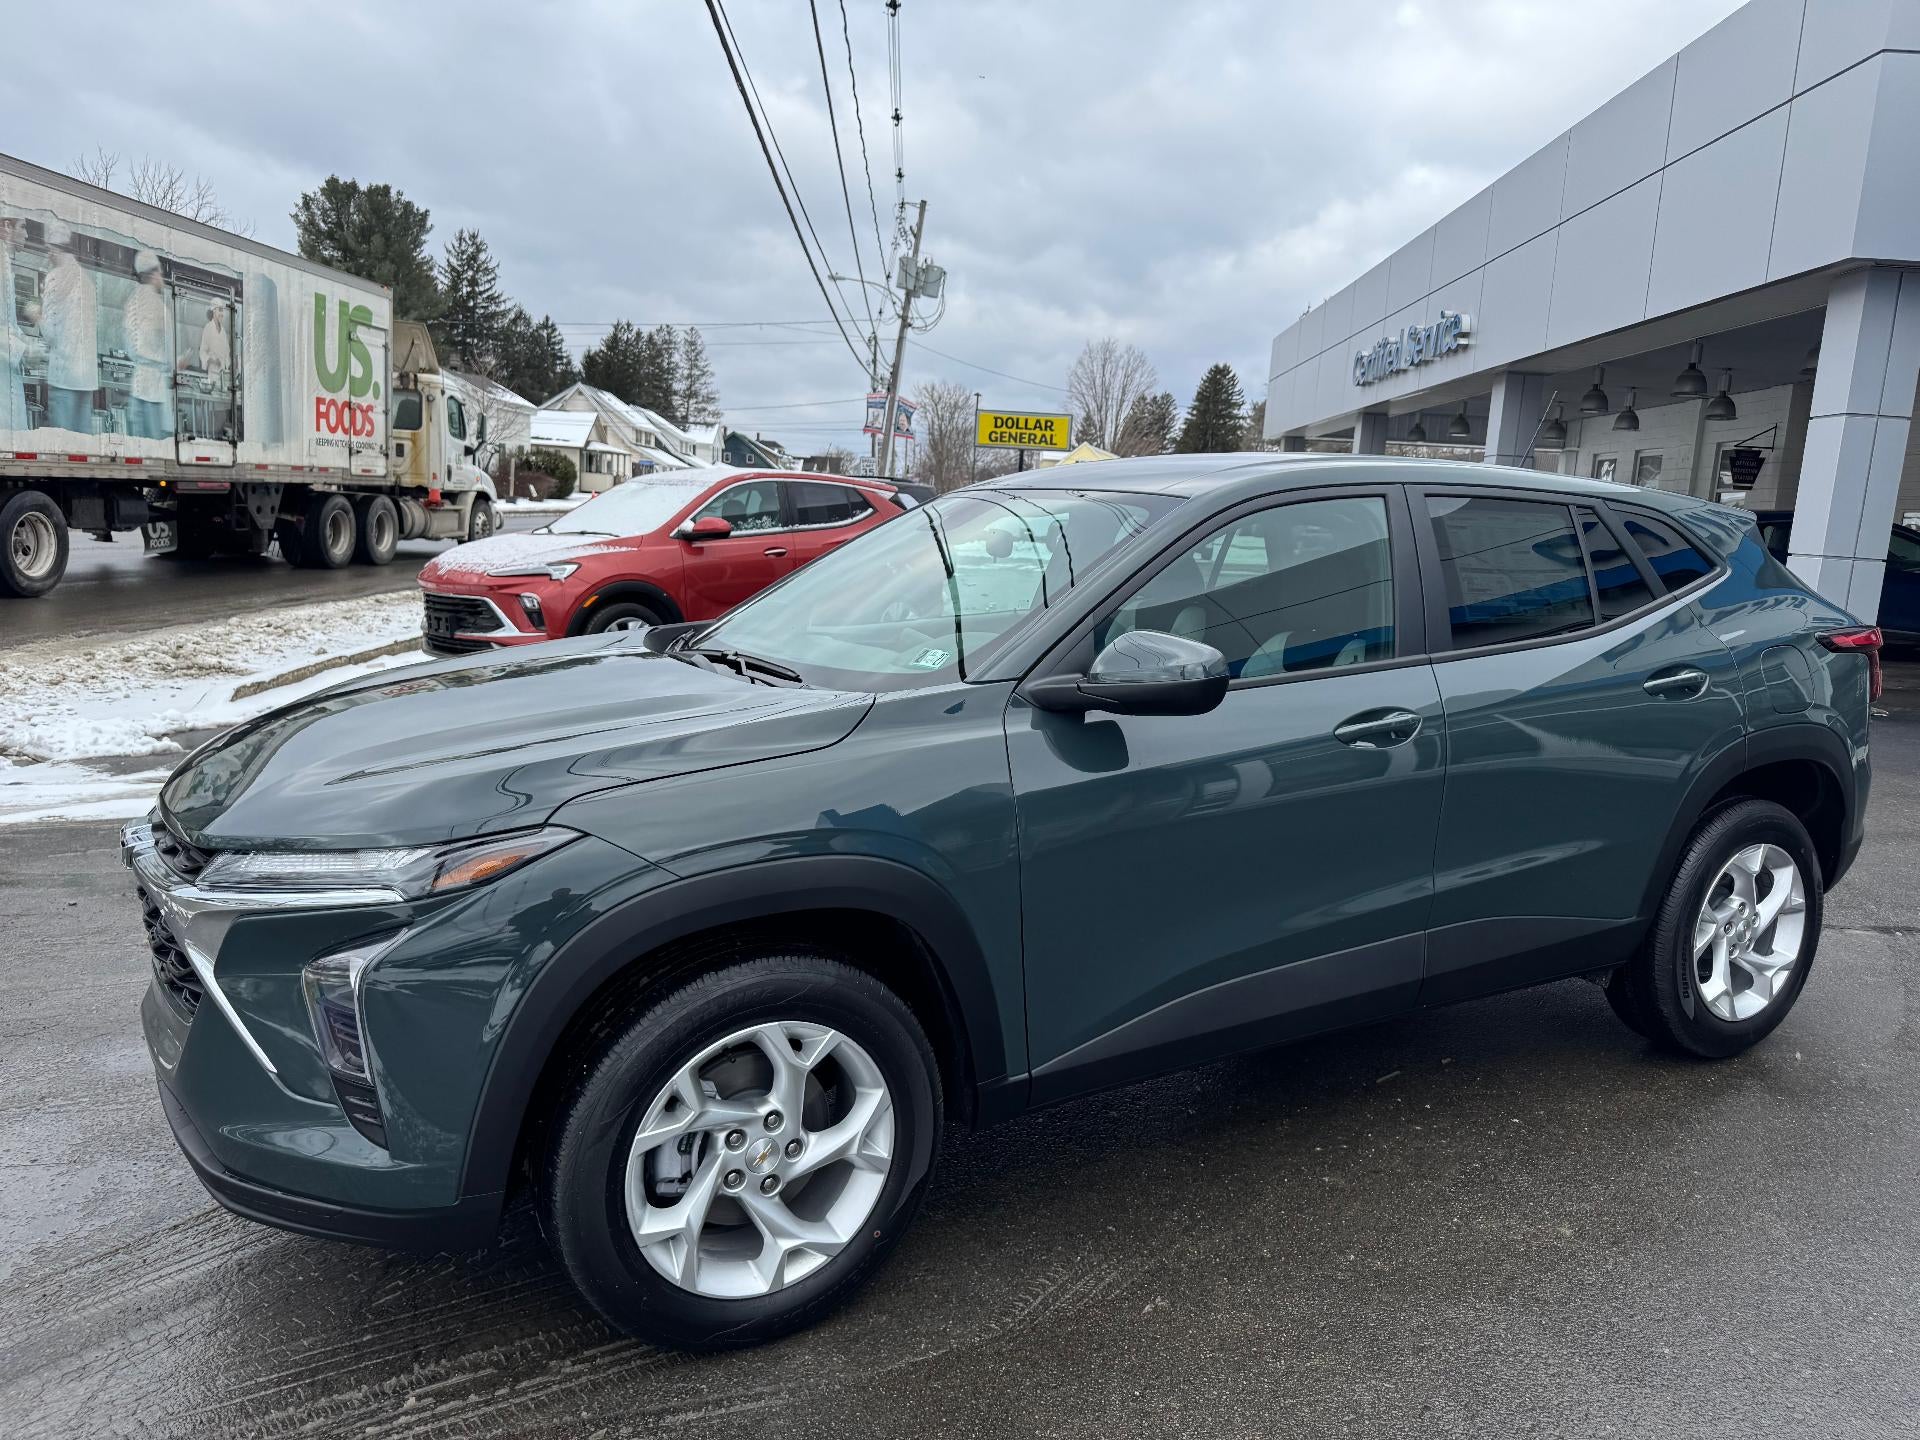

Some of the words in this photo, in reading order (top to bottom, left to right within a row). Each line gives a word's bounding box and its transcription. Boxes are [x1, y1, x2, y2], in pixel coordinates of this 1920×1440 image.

[1352, 328, 1406, 387] Certified
[1405, 309, 1468, 367] Service
[315, 396, 375, 438] FOODS
[993, 415, 1055, 432] DOLLAR
[988, 430, 1058, 446] GENERAL
